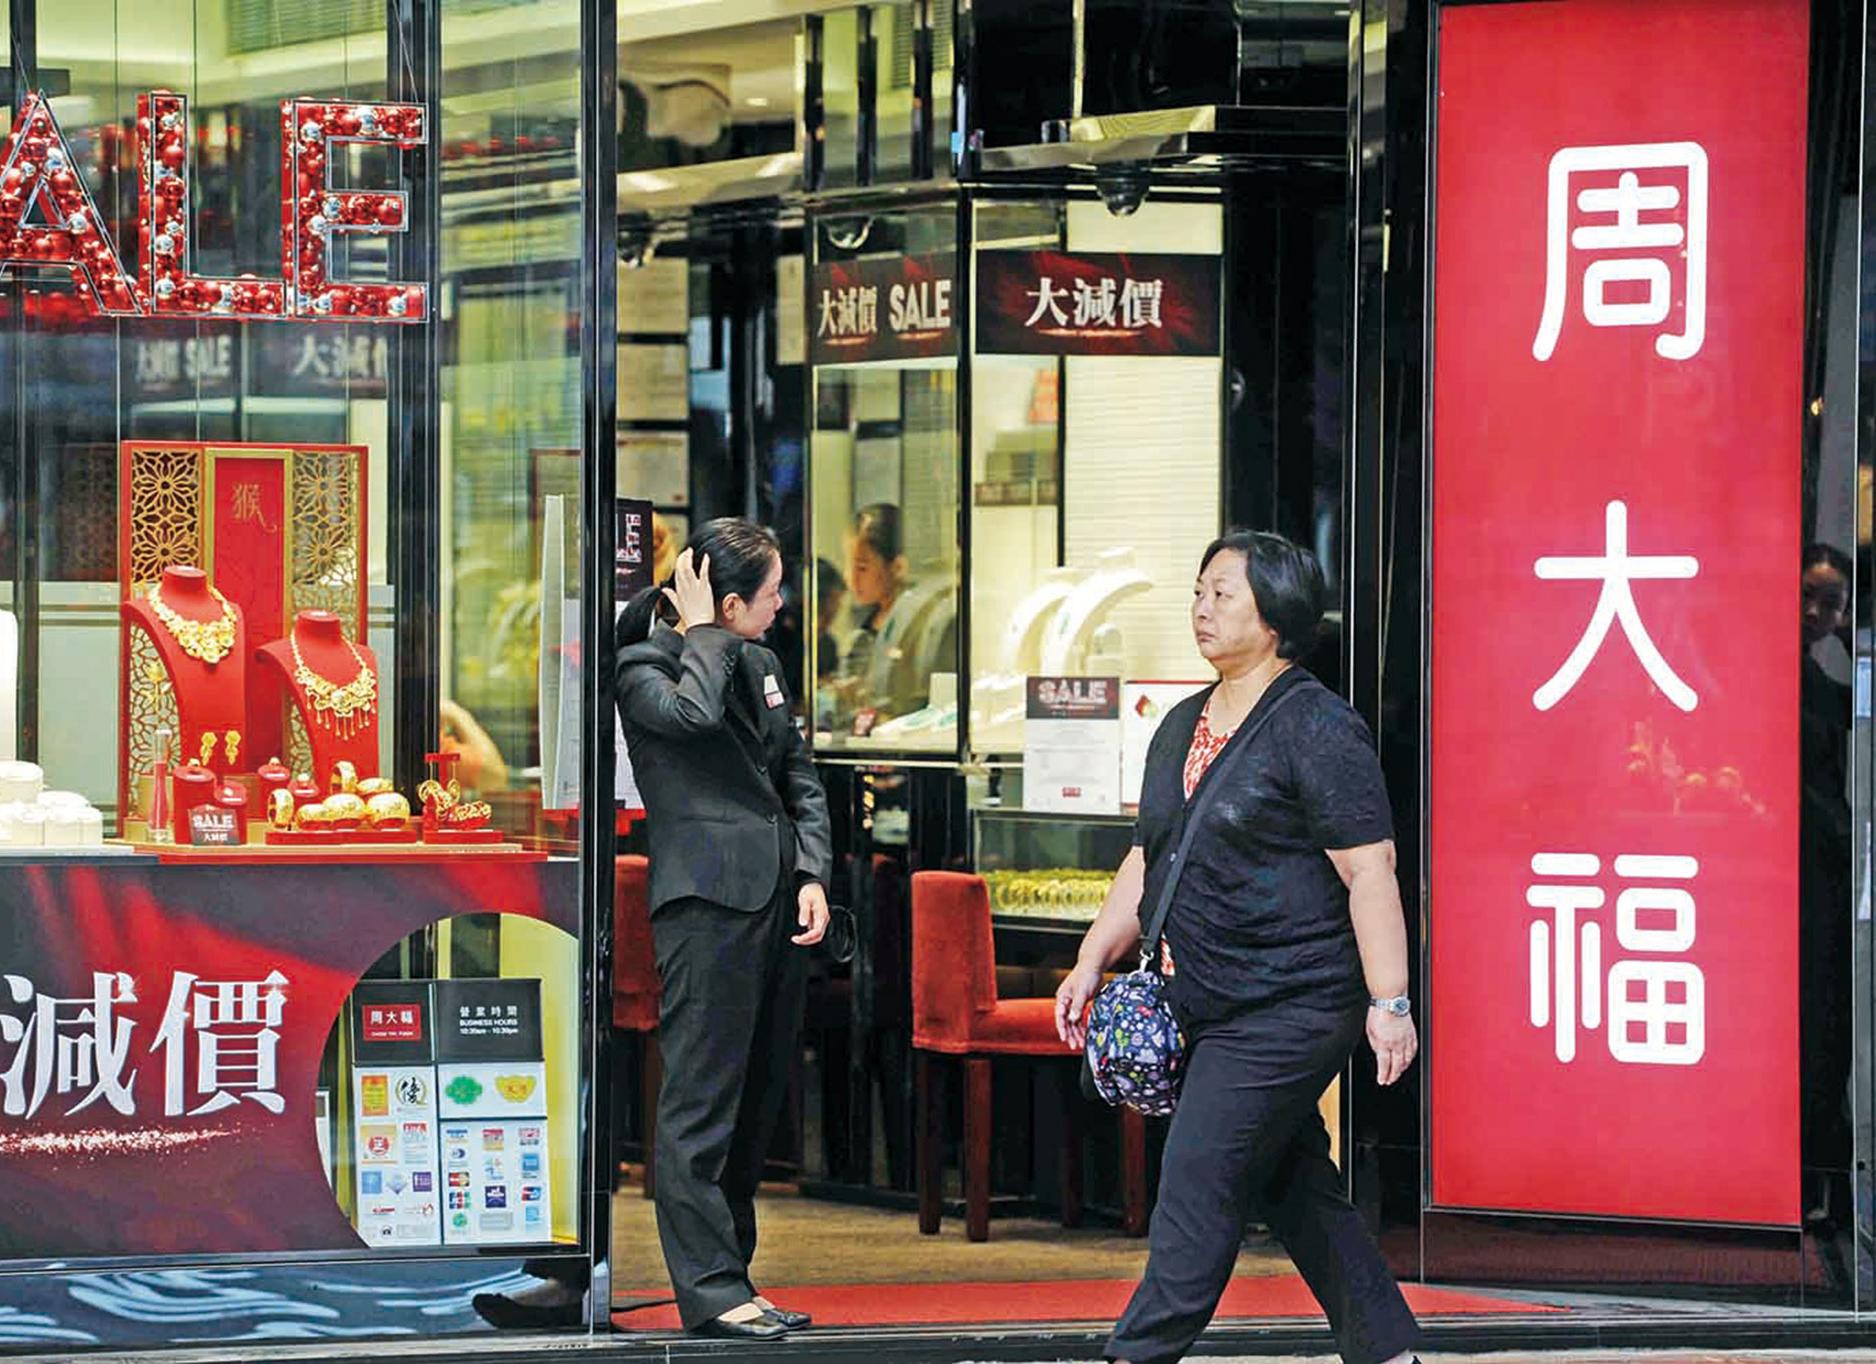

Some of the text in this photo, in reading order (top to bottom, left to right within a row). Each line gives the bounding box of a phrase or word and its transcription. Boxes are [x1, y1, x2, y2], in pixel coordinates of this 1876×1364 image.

[0, 88, 430, 323] ALE
[816, 286, 878, 337] 大減價
[889, 279, 952, 332] SALE
[1024, 277, 1164, 329] 大減價
[1525, 141, 1709, 1067] 周大福
[1038, 679, 1108, 705] SALE
[192, 813, 235, 829] SALE
[0, 969, 290, 1120] 減價
